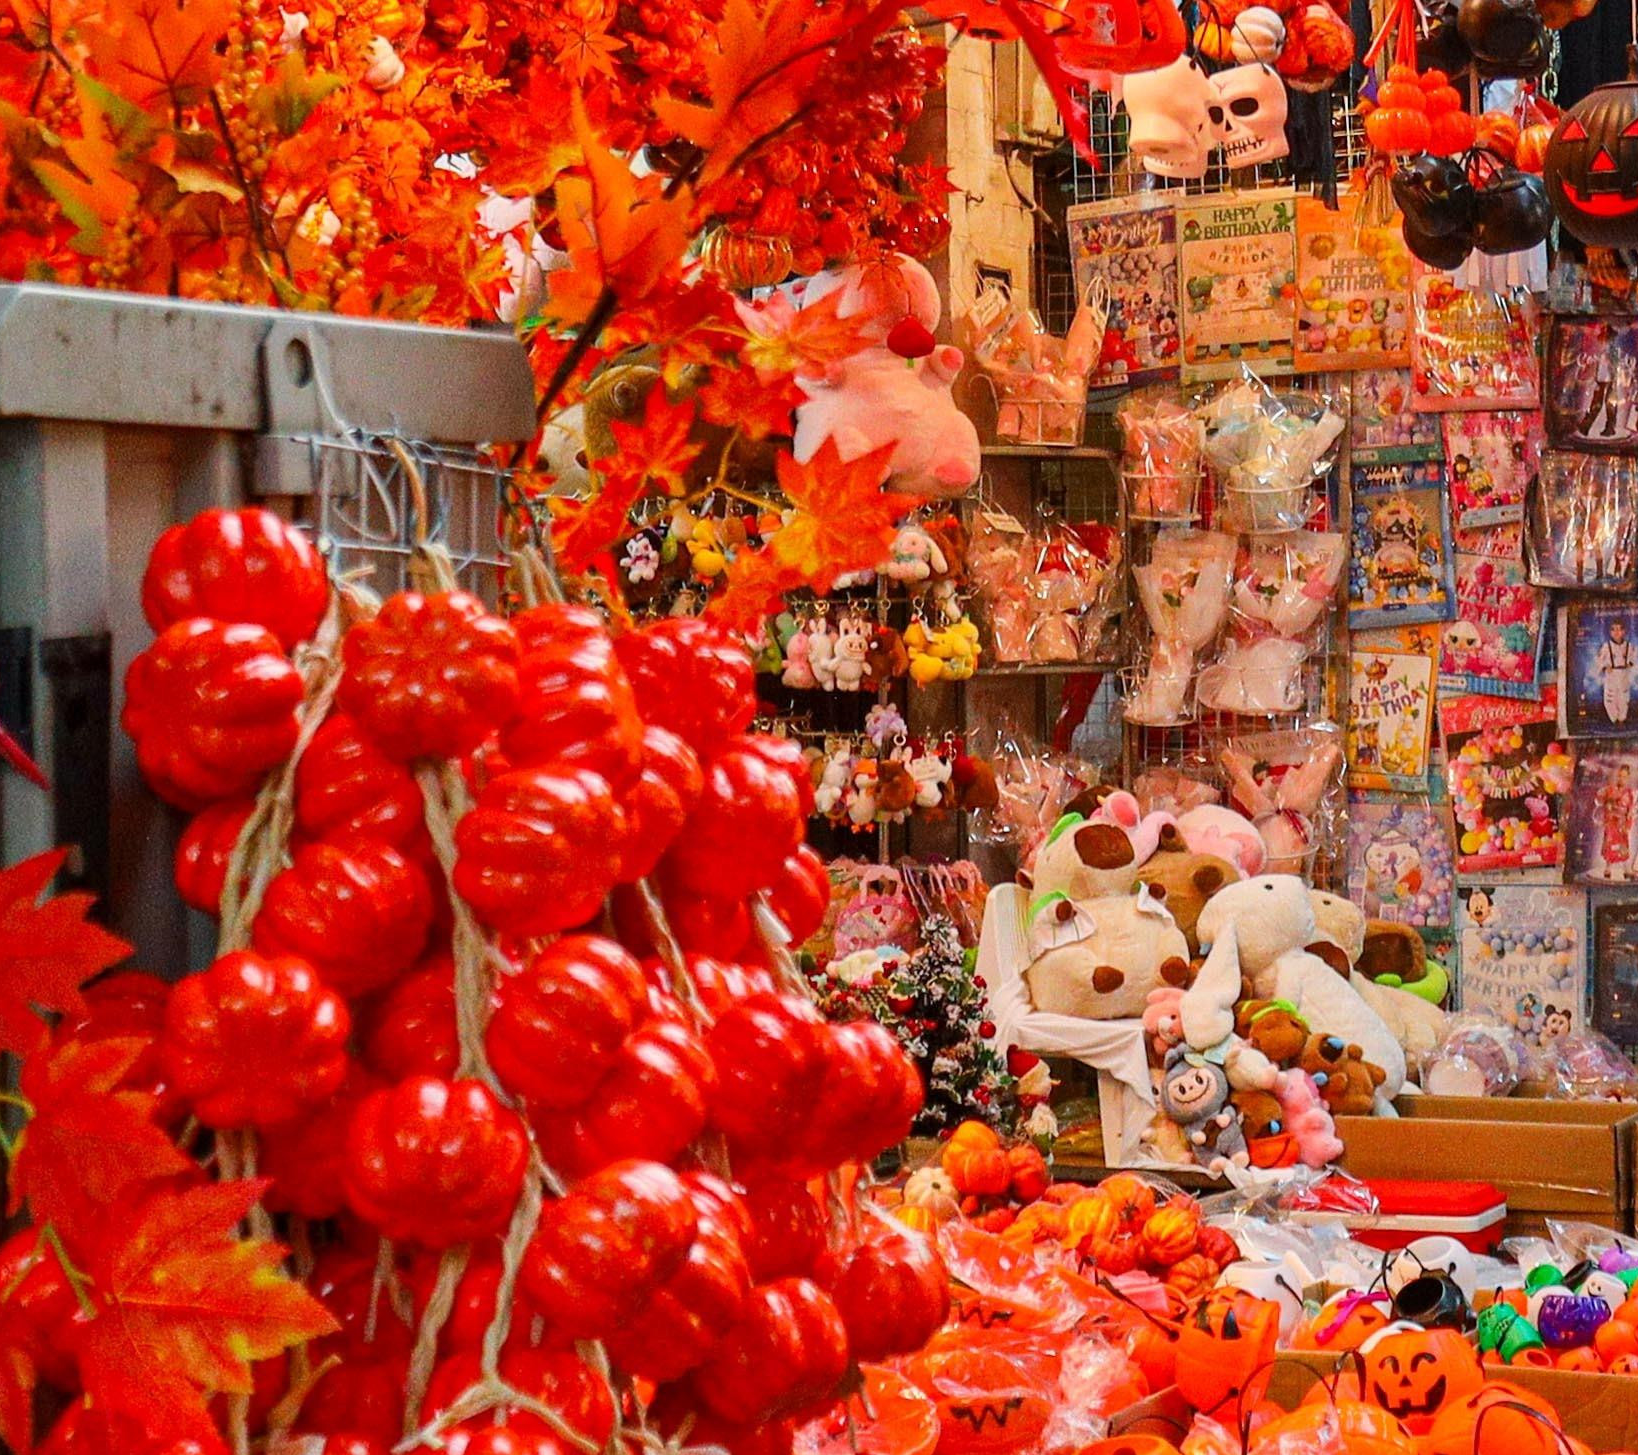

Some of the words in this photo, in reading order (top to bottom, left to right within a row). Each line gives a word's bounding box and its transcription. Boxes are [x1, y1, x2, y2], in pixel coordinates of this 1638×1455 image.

[1213, 203, 1260, 223] HAPPY
[1204, 218, 1273, 239] BIRTHDAY
[1350, 681, 1430, 719] BIRTHDAY
[1360, 675, 1409, 702] HAPPY
